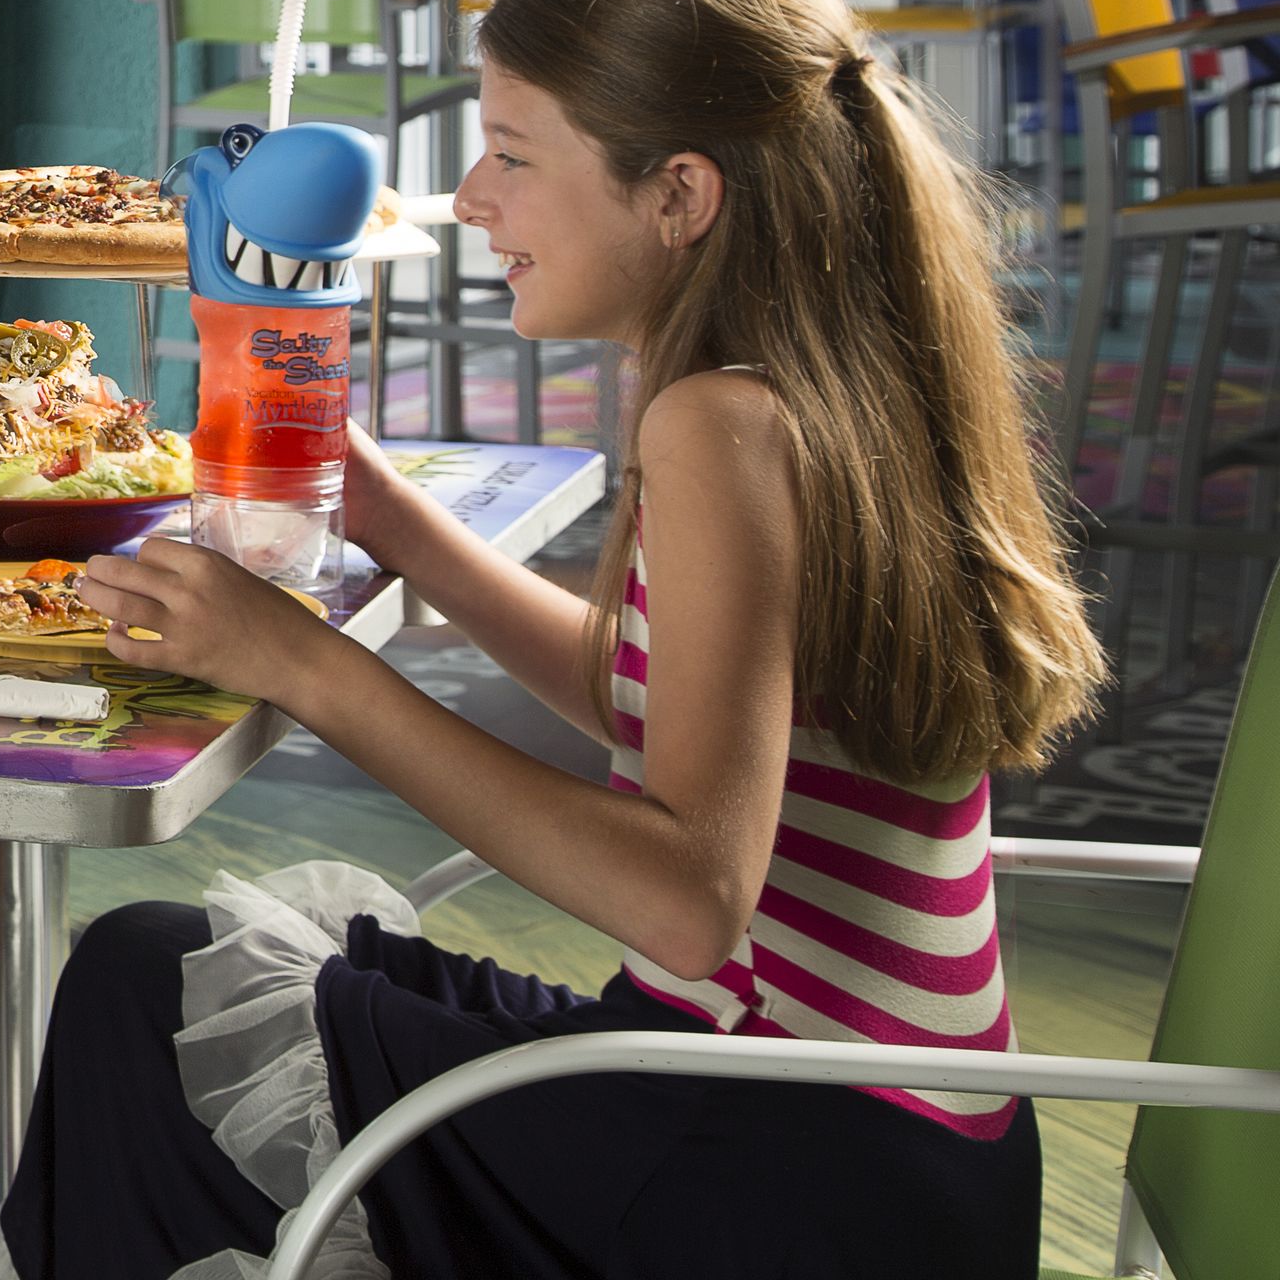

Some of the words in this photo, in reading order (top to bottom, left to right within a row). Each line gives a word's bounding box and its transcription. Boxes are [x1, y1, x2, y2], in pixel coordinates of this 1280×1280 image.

[251, 329, 332, 358] Salty
[263, 358, 285, 370] the
[284, 356, 349, 385] Shark
[246, 387, 295, 399] Vacation
